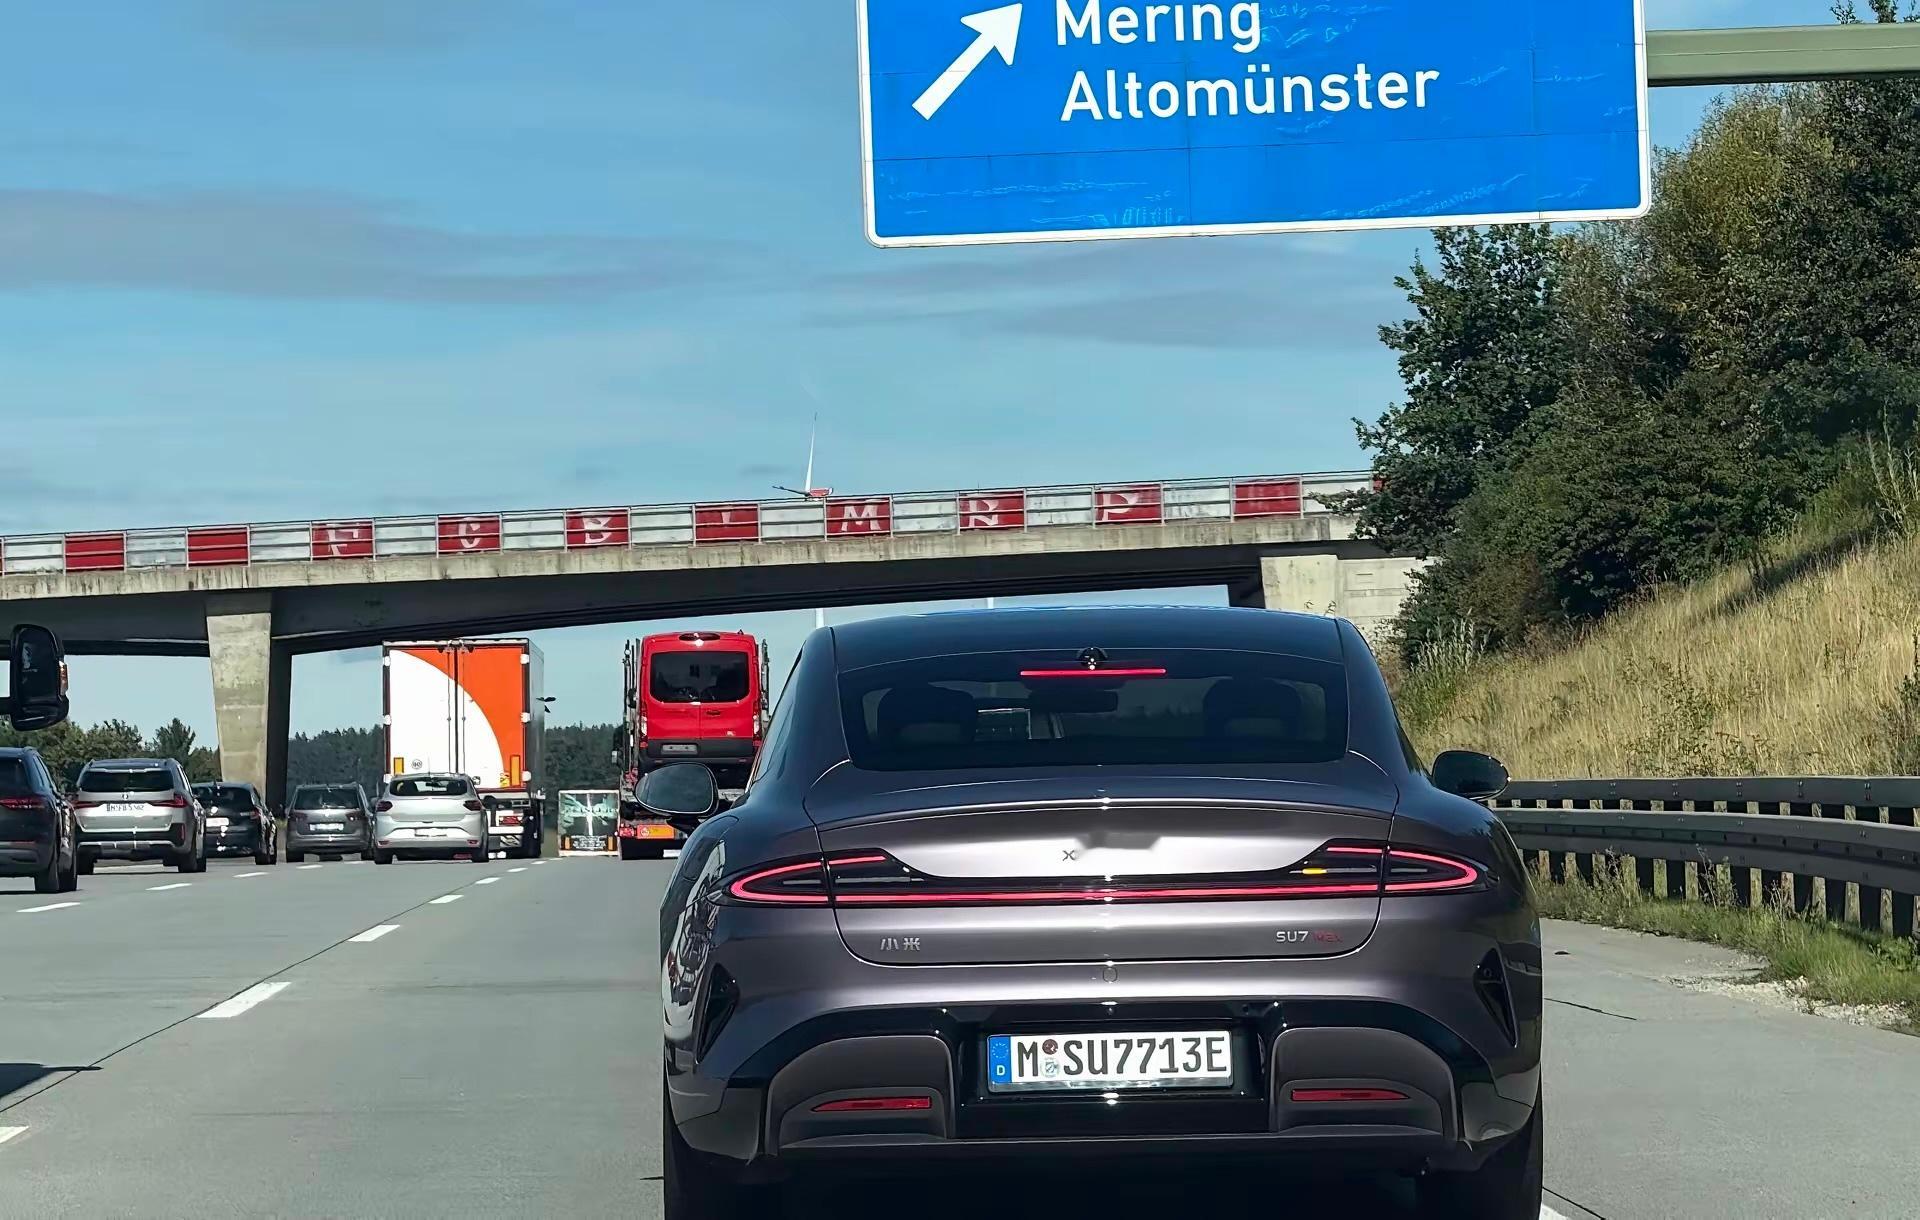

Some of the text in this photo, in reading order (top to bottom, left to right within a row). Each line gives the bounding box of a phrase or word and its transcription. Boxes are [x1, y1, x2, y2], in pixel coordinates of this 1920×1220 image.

[1056, 0, 1261, 53] Mering
[1060, 63, 1441, 122] Altomünster
[1276, 930, 1309, 942] SU7
[880, 937, 920, 951] 小米
[996, 1065, 1006, 1076] D
